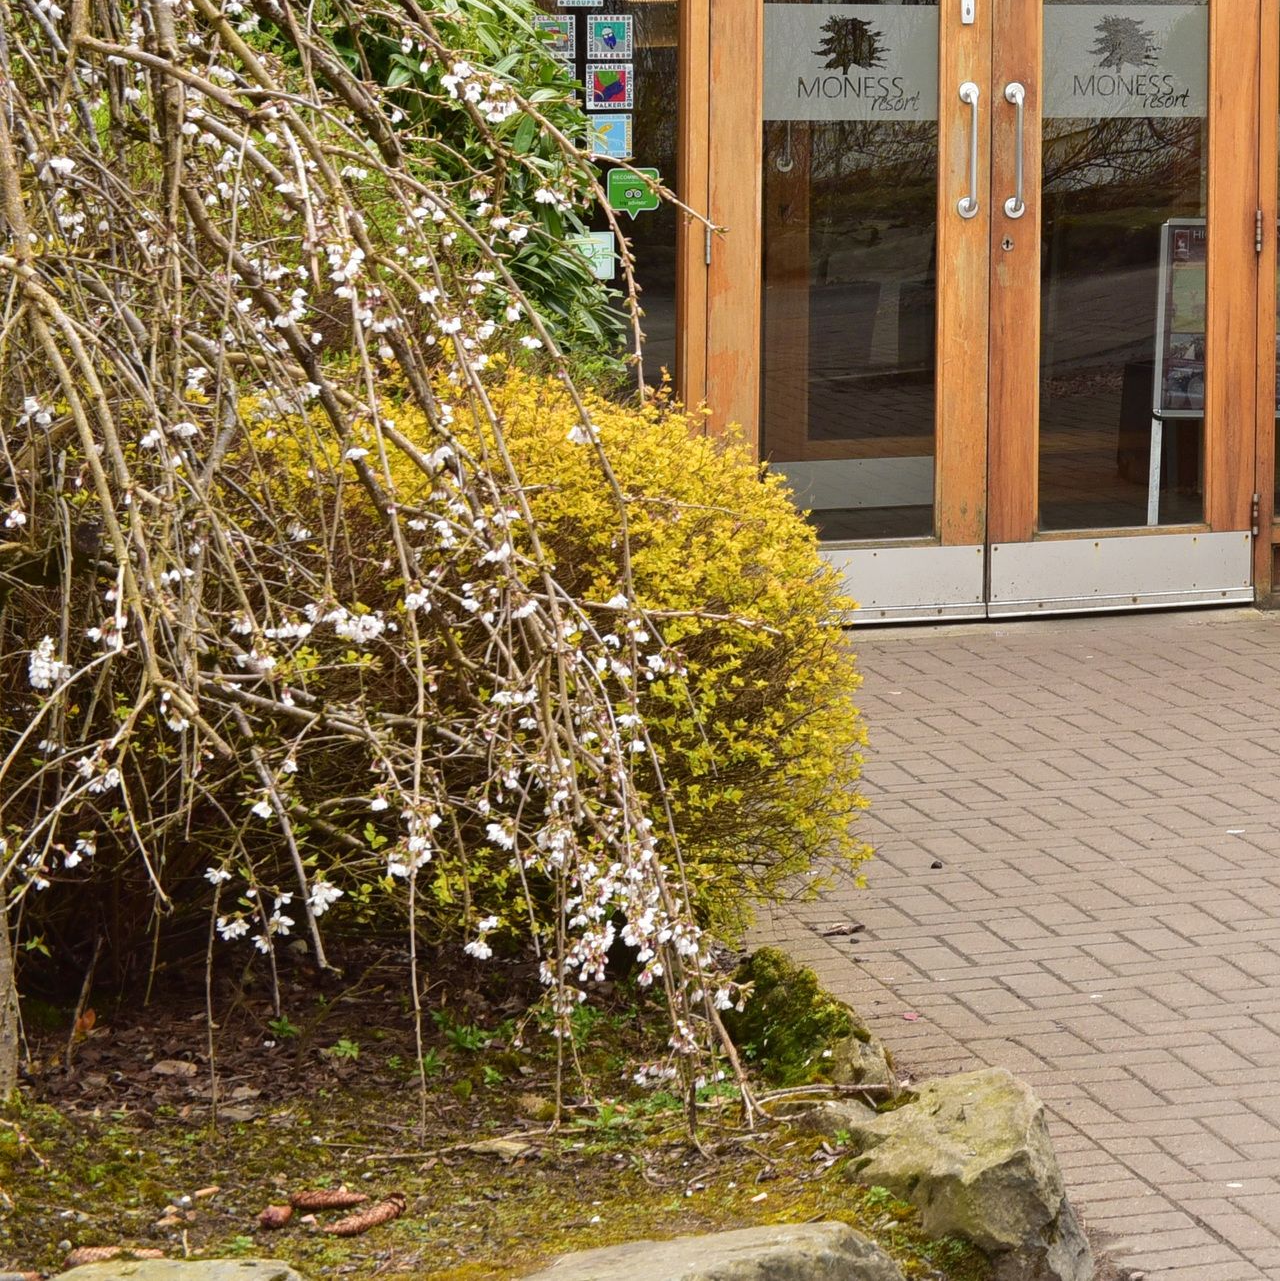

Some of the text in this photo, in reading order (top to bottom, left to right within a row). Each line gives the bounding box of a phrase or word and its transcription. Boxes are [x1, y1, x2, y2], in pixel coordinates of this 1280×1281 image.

[796, 75, 904, 99] MONESS
[1072, 74, 1175, 98] MONESS
[870, 91, 922, 113] resort
[1142, 89, 1191, 110] resort
